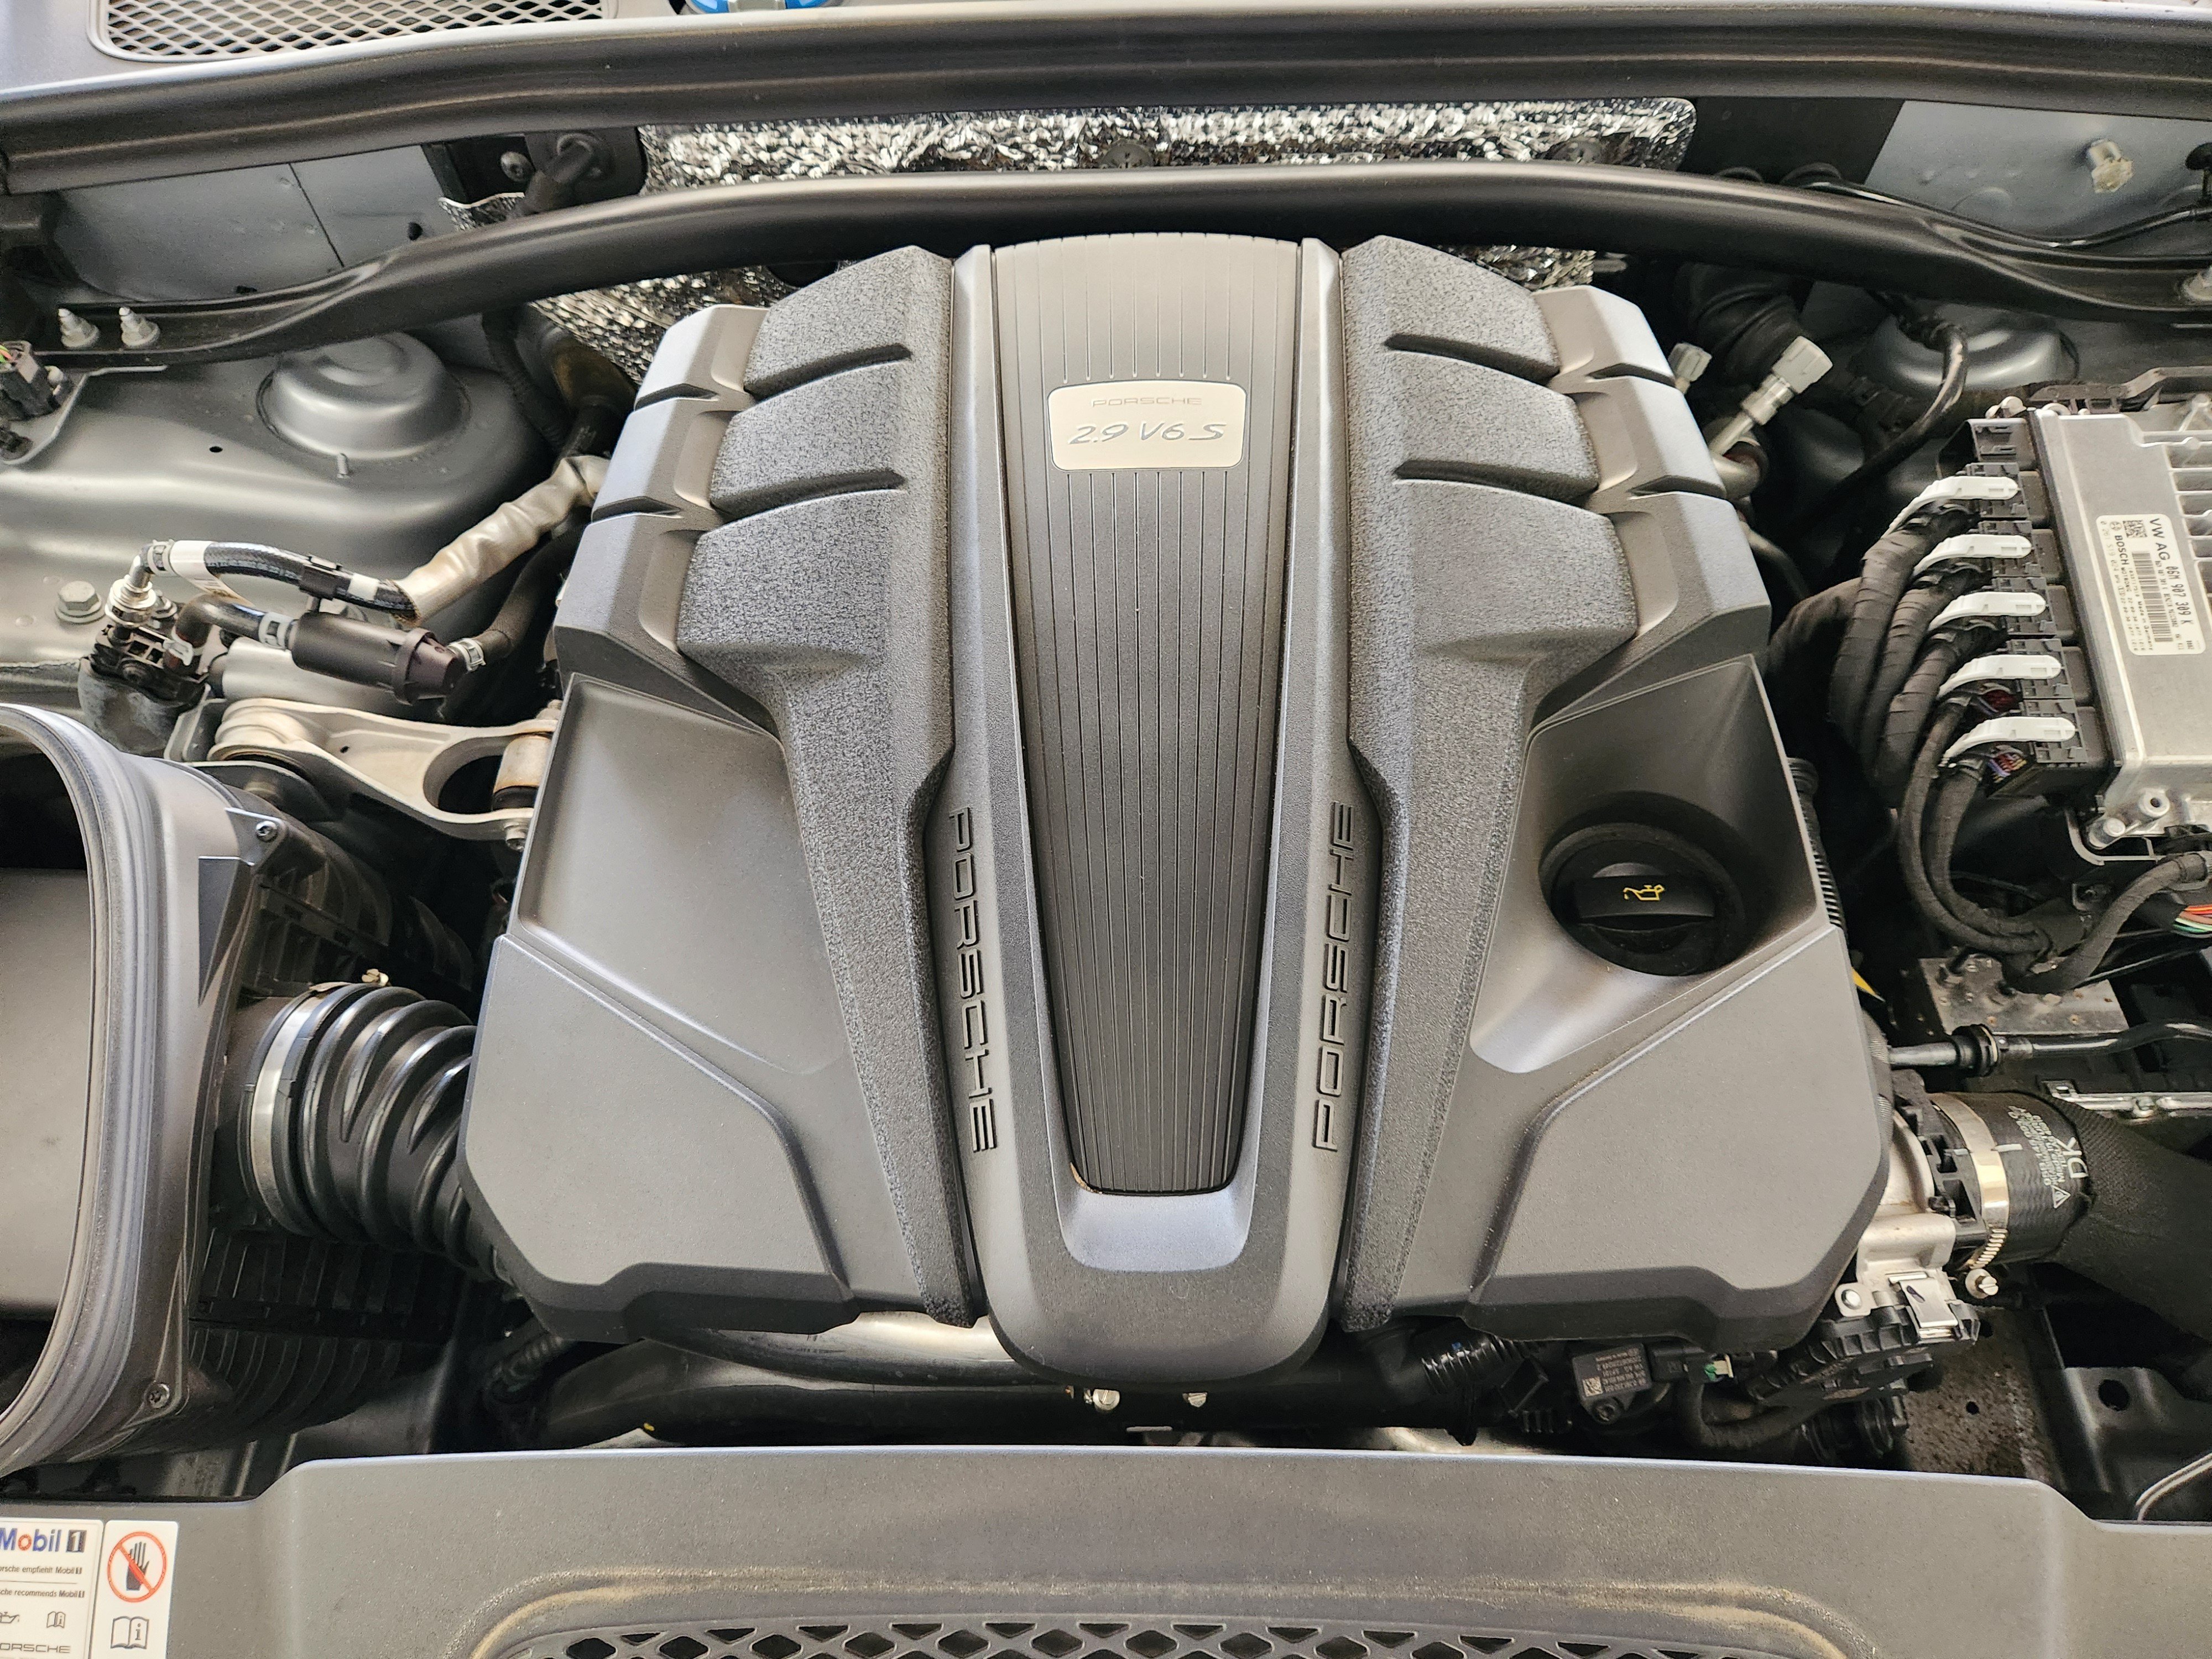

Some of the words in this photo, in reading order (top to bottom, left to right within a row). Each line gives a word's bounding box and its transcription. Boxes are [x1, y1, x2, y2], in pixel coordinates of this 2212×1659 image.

[1092, 397, 1202, 407] PORSCHE
[1068, 422, 1129, 444] 2.9
[1140, 421, 1185, 441] V6
[1188, 423, 1227, 441] S
[2150, 518, 2164, 538] VW
[2114, 535, 2129, 565] BOSCH
[2155, 542, 2170, 560] AG
[2171, 583, 2186, 597] 907
[2175, 602, 2191, 615] 309
[949, 807, 997, 1152] PORSCHE
[1313, 801, 1354, 1152] PORSCHE
[2056, 1136, 2089, 1178] DK
[0, 1528, 61, 1552] Mobil
